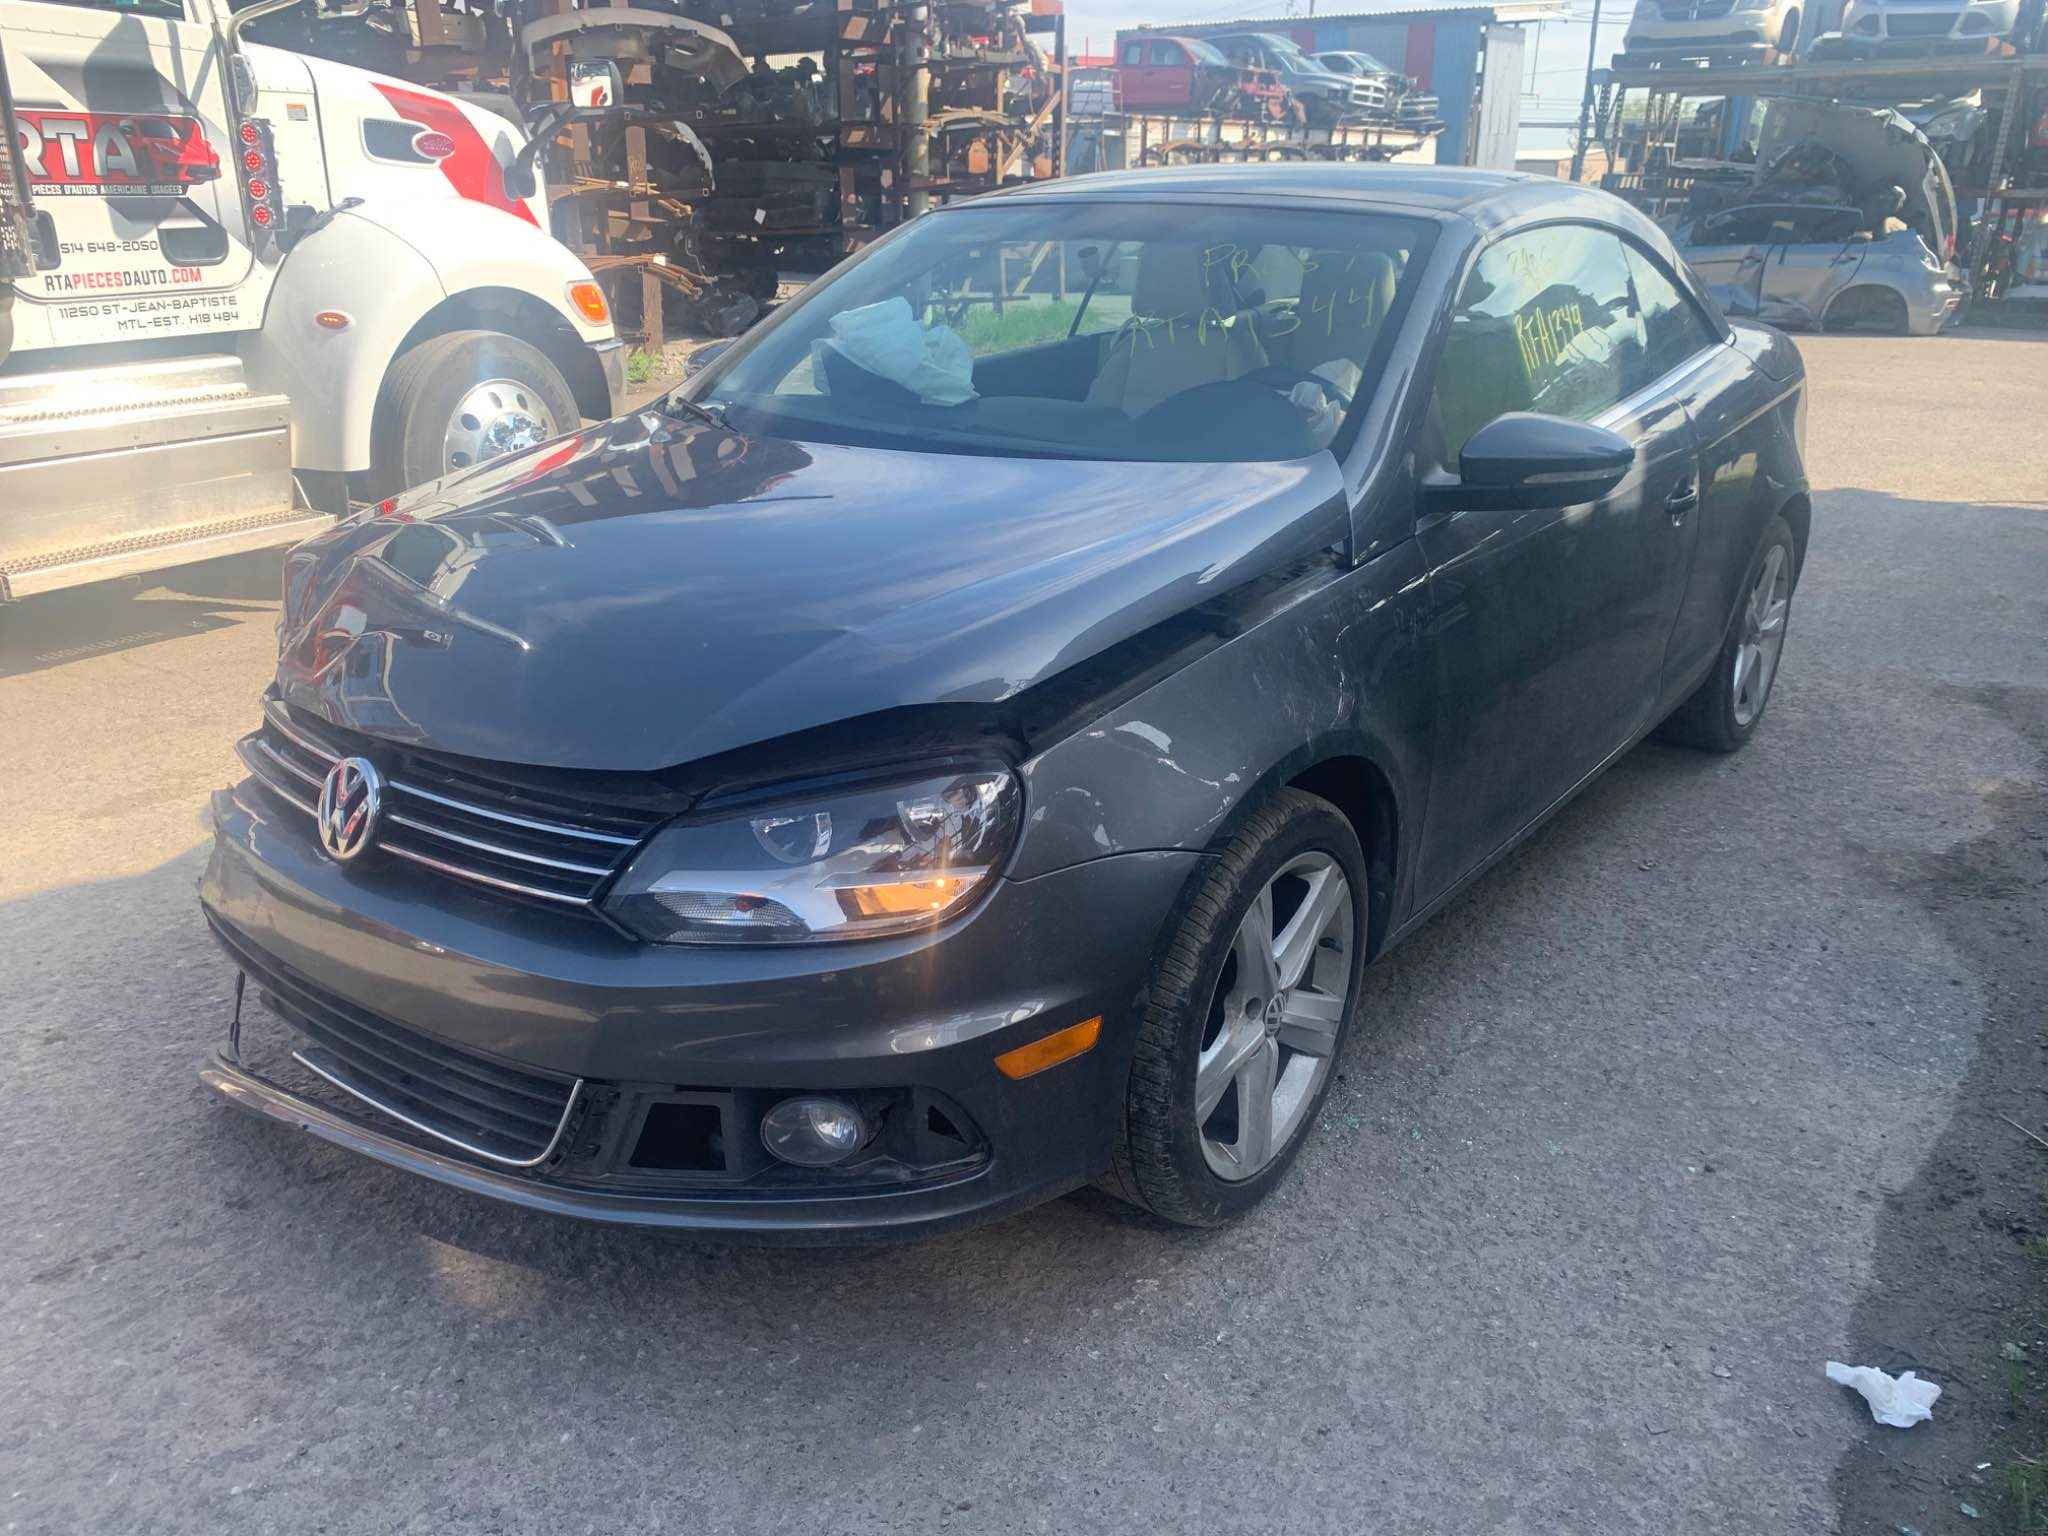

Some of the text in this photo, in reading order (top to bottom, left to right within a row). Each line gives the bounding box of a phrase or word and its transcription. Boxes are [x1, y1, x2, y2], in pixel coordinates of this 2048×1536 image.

[17, 116, 139, 177] RTA
[60, 240, 158, 254] 514 648-2050
[44, 267, 202, 291] RTAPIECESDAUTO.COM
[58, 295, 238, 319] 11250 ST-JEAN-BAPTISTE
[117, 315, 185, 330] MTL-EST.
